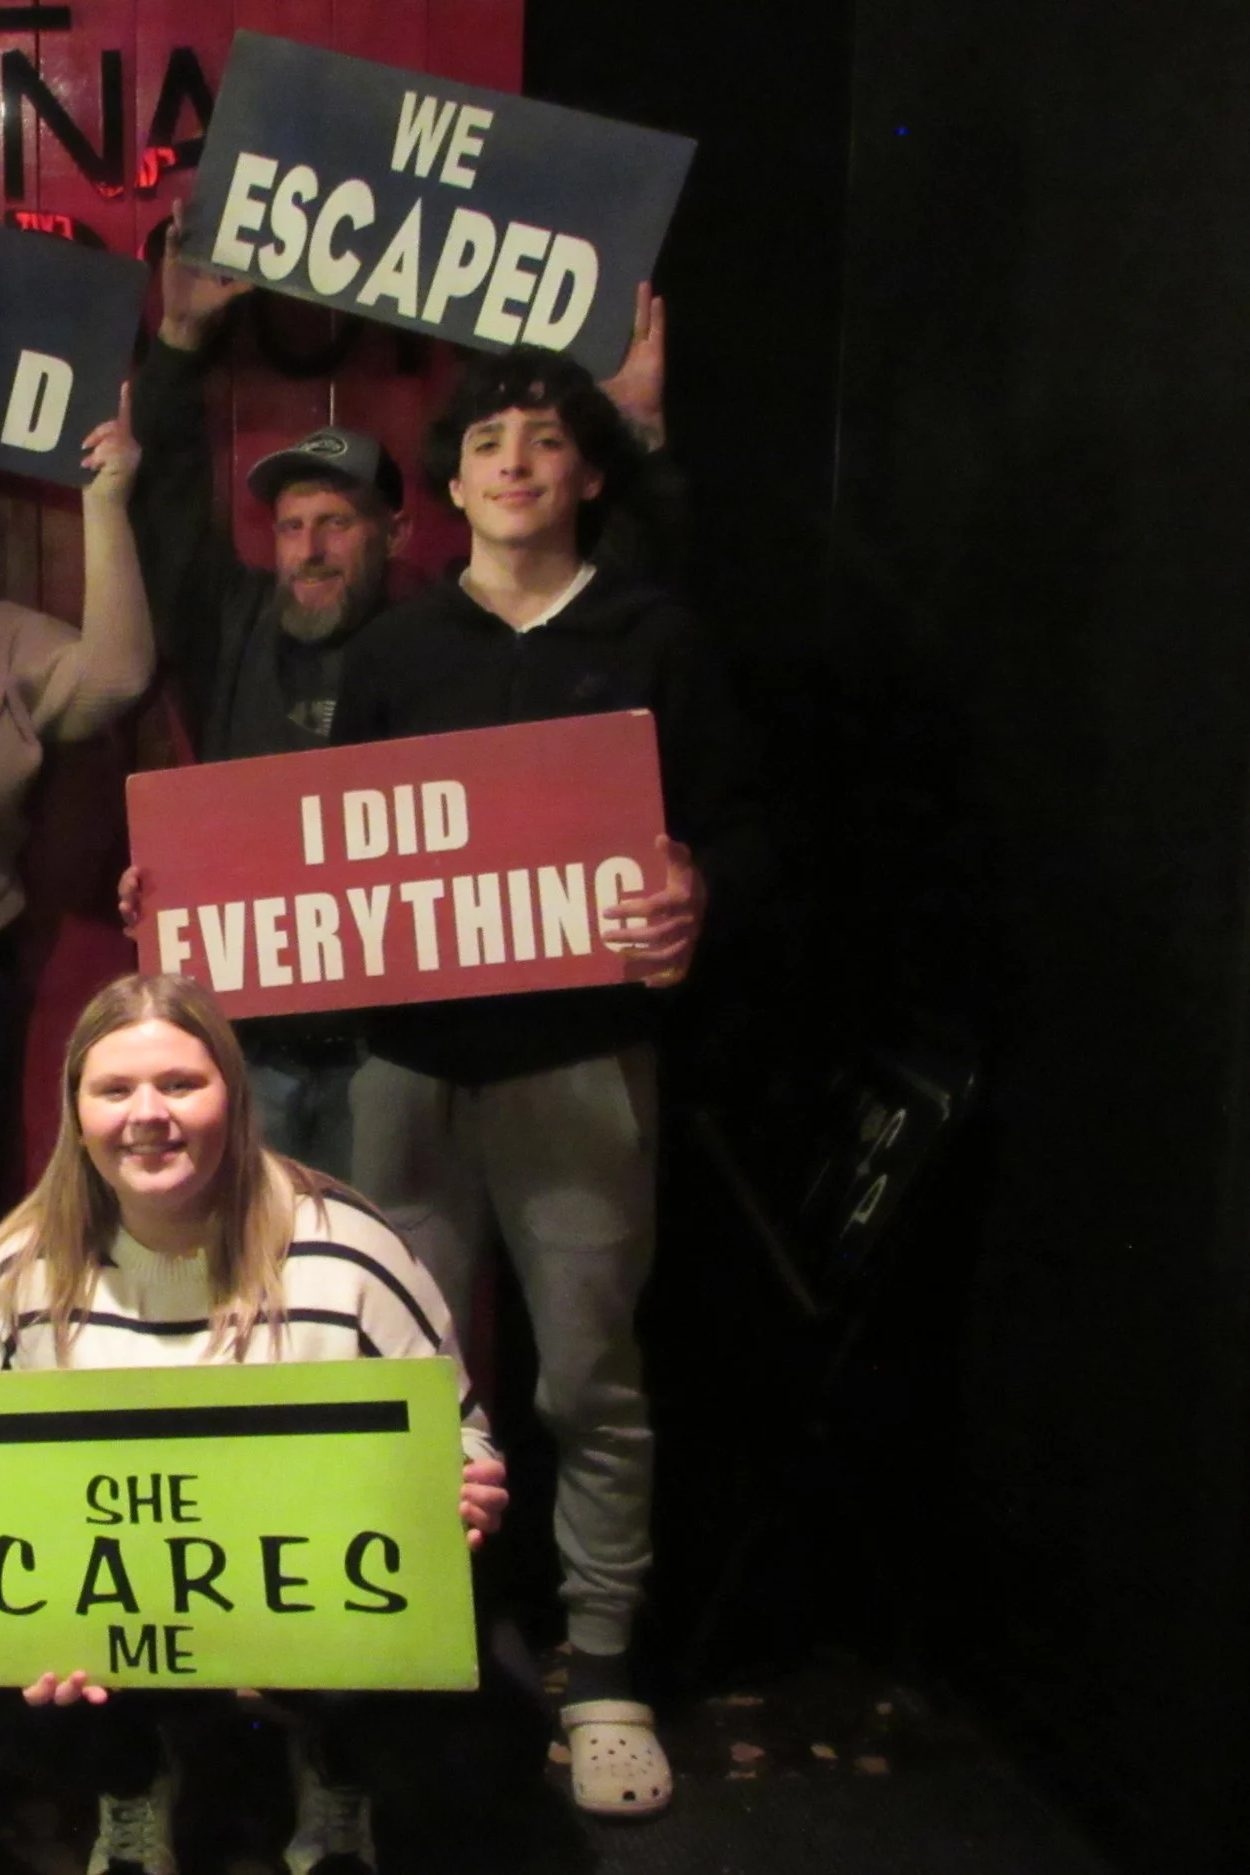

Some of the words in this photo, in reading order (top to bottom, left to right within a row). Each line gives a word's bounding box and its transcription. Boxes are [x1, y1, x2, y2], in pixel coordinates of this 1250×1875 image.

[391, 90, 494, 189] WE
[211, 152, 599, 351] ESCAPED
[301, 795, 325, 865] I
[343, 779, 469, 861] DID
[86, 1473, 201, 1525] SHE
[107, 1624, 197, 1675] ME
